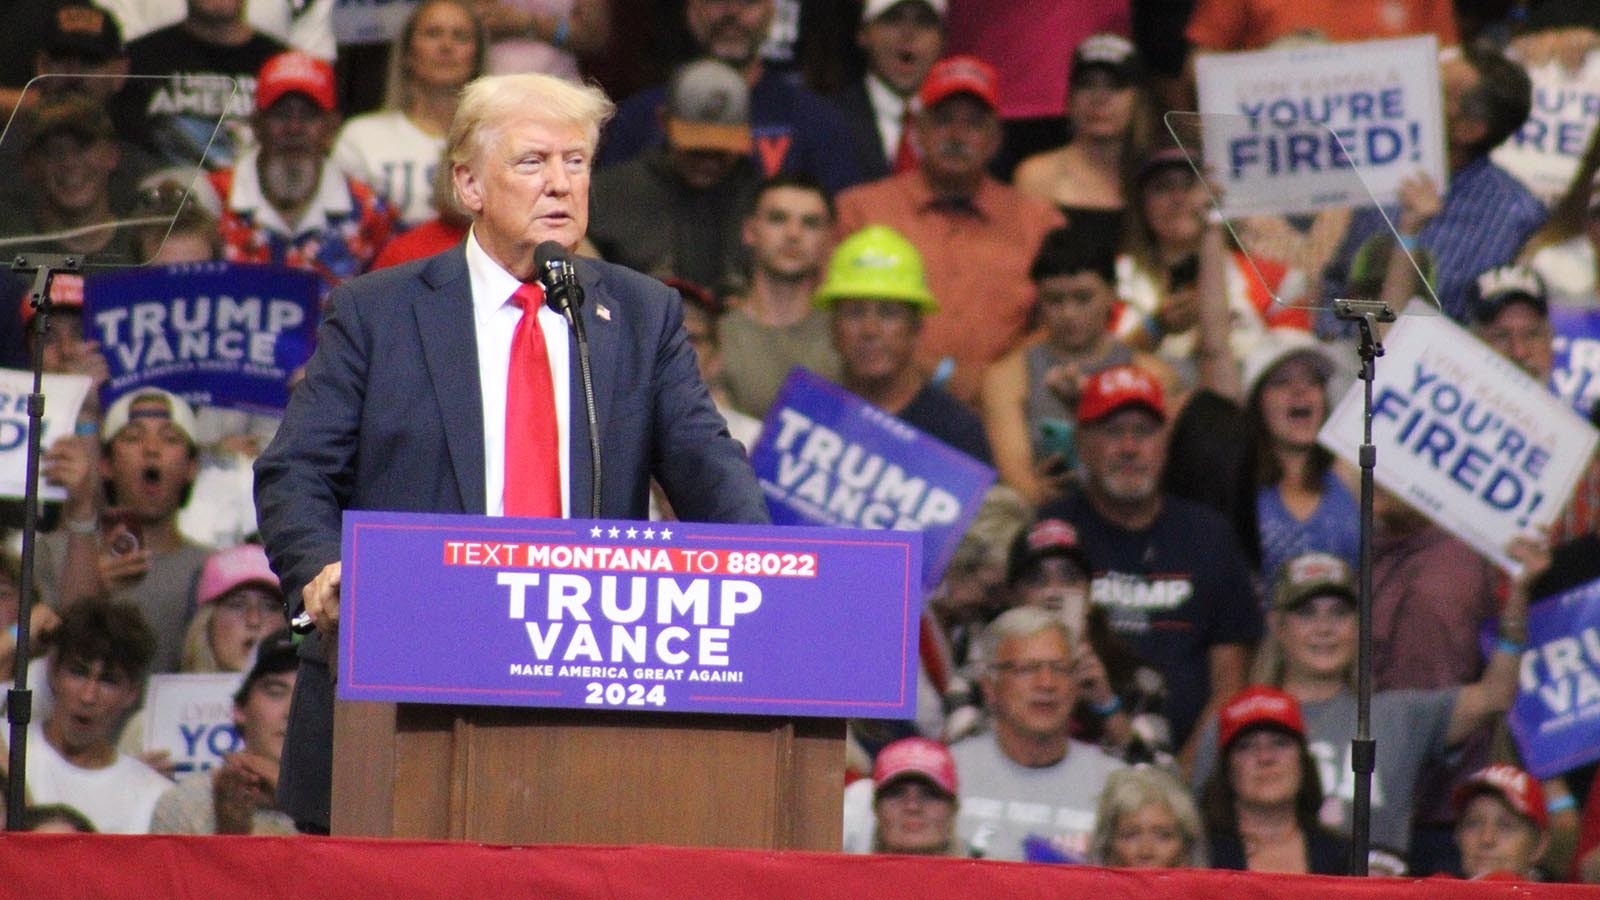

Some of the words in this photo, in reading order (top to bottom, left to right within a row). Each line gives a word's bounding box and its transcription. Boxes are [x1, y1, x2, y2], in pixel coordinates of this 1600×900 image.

[1240, 87, 1404, 130] YOU'RE
[1228, 121, 1421, 181] FIRED!
[94, 295, 305, 347] TRUMP
[117, 330, 277, 372] VANCE
[1408, 363, 1552, 481] YOU'RE
[775, 406, 961, 525] TRUMP
[1370, 385, 1545, 529] FIRED!
[447, 542, 520, 566] TEXT
[527, 545, 673, 571] MONTANA
[681, 550, 719, 574] TO
[726, 552, 815, 577] 88022
[496, 571, 763, 627] TRUMP
[525, 621, 730, 666] VANCE
[510, 664, 554, 677] MAKE
[558, 665, 629, 679] AMERICA
[633, 667, 685, 681] GREAT
[688, 670, 744, 683] AGAIN!
[585, 682, 667, 707] 2024
